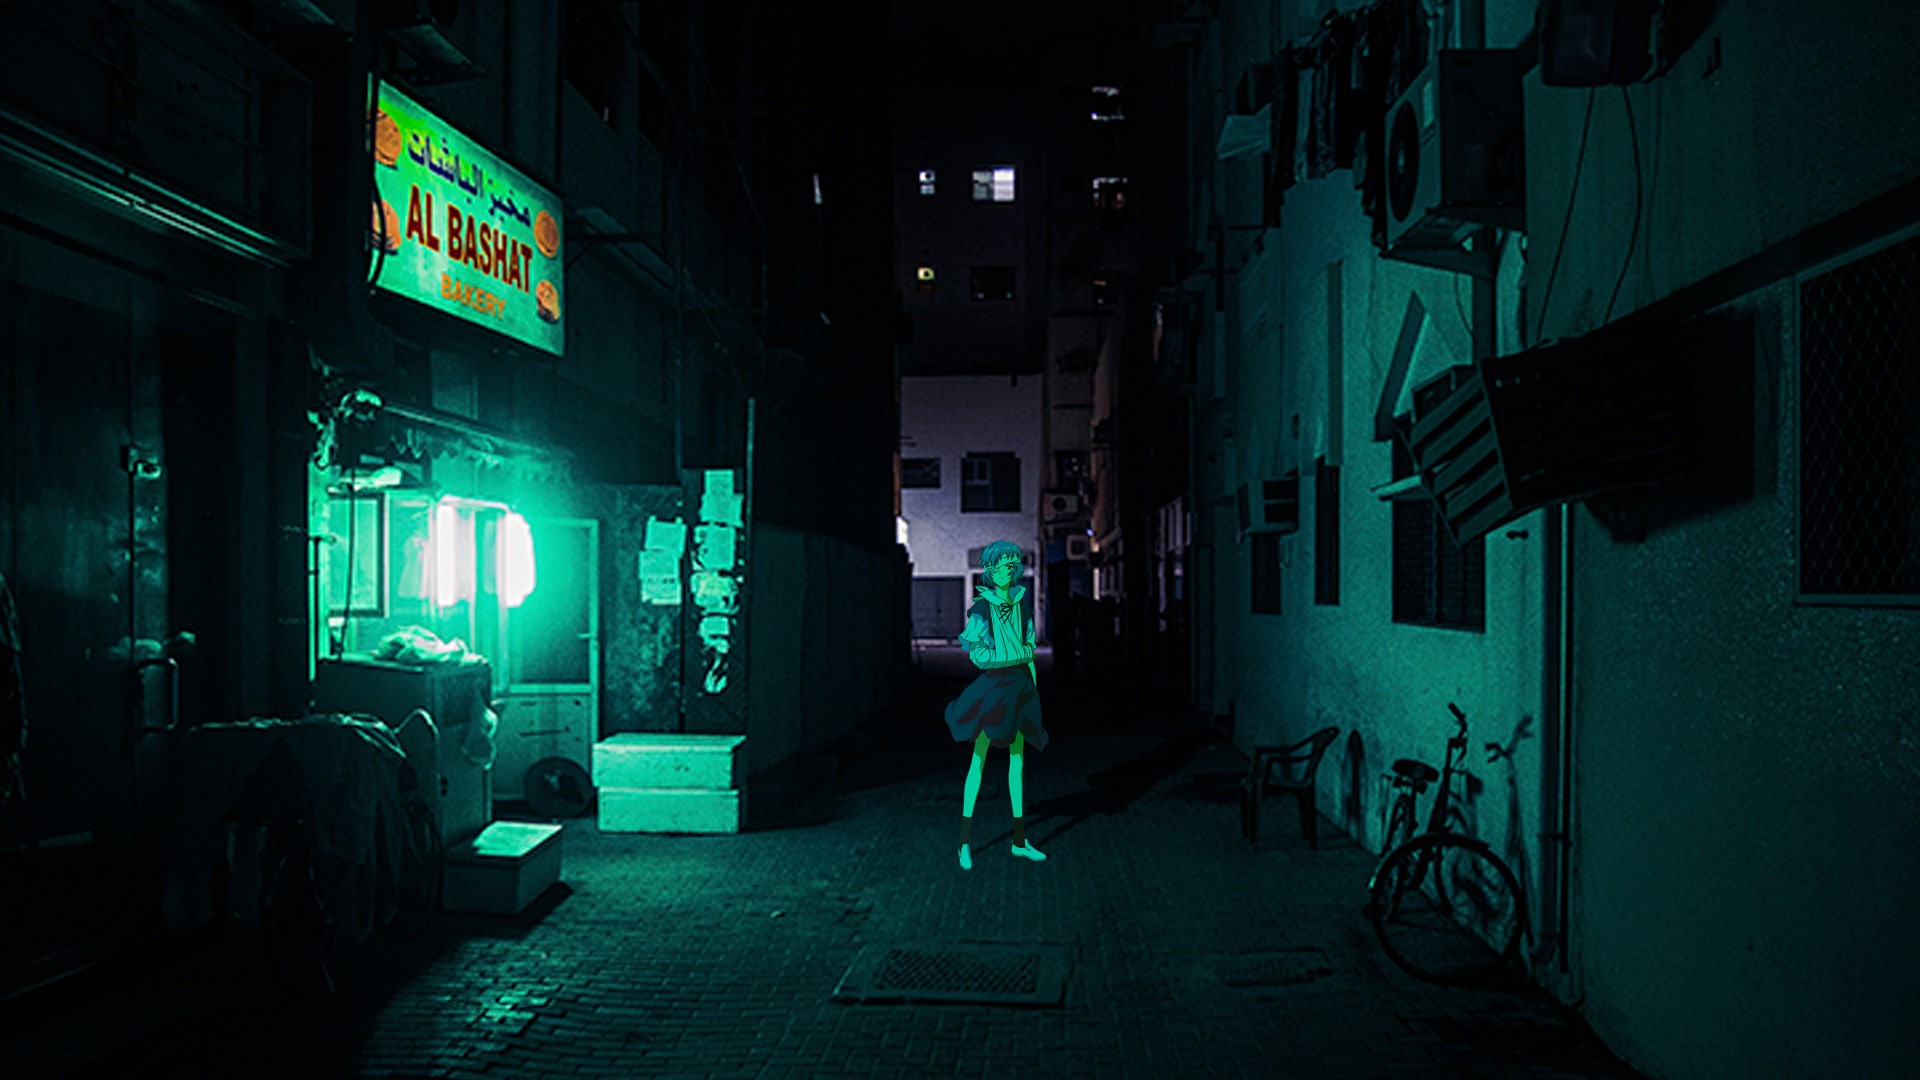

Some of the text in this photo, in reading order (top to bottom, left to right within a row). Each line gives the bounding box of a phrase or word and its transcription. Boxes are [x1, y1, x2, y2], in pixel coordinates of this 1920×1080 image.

[488, 178, 531, 228] مخبز
[406, 184, 533, 293] AL BASHAT
[440, 273, 506, 320] BAKERY
